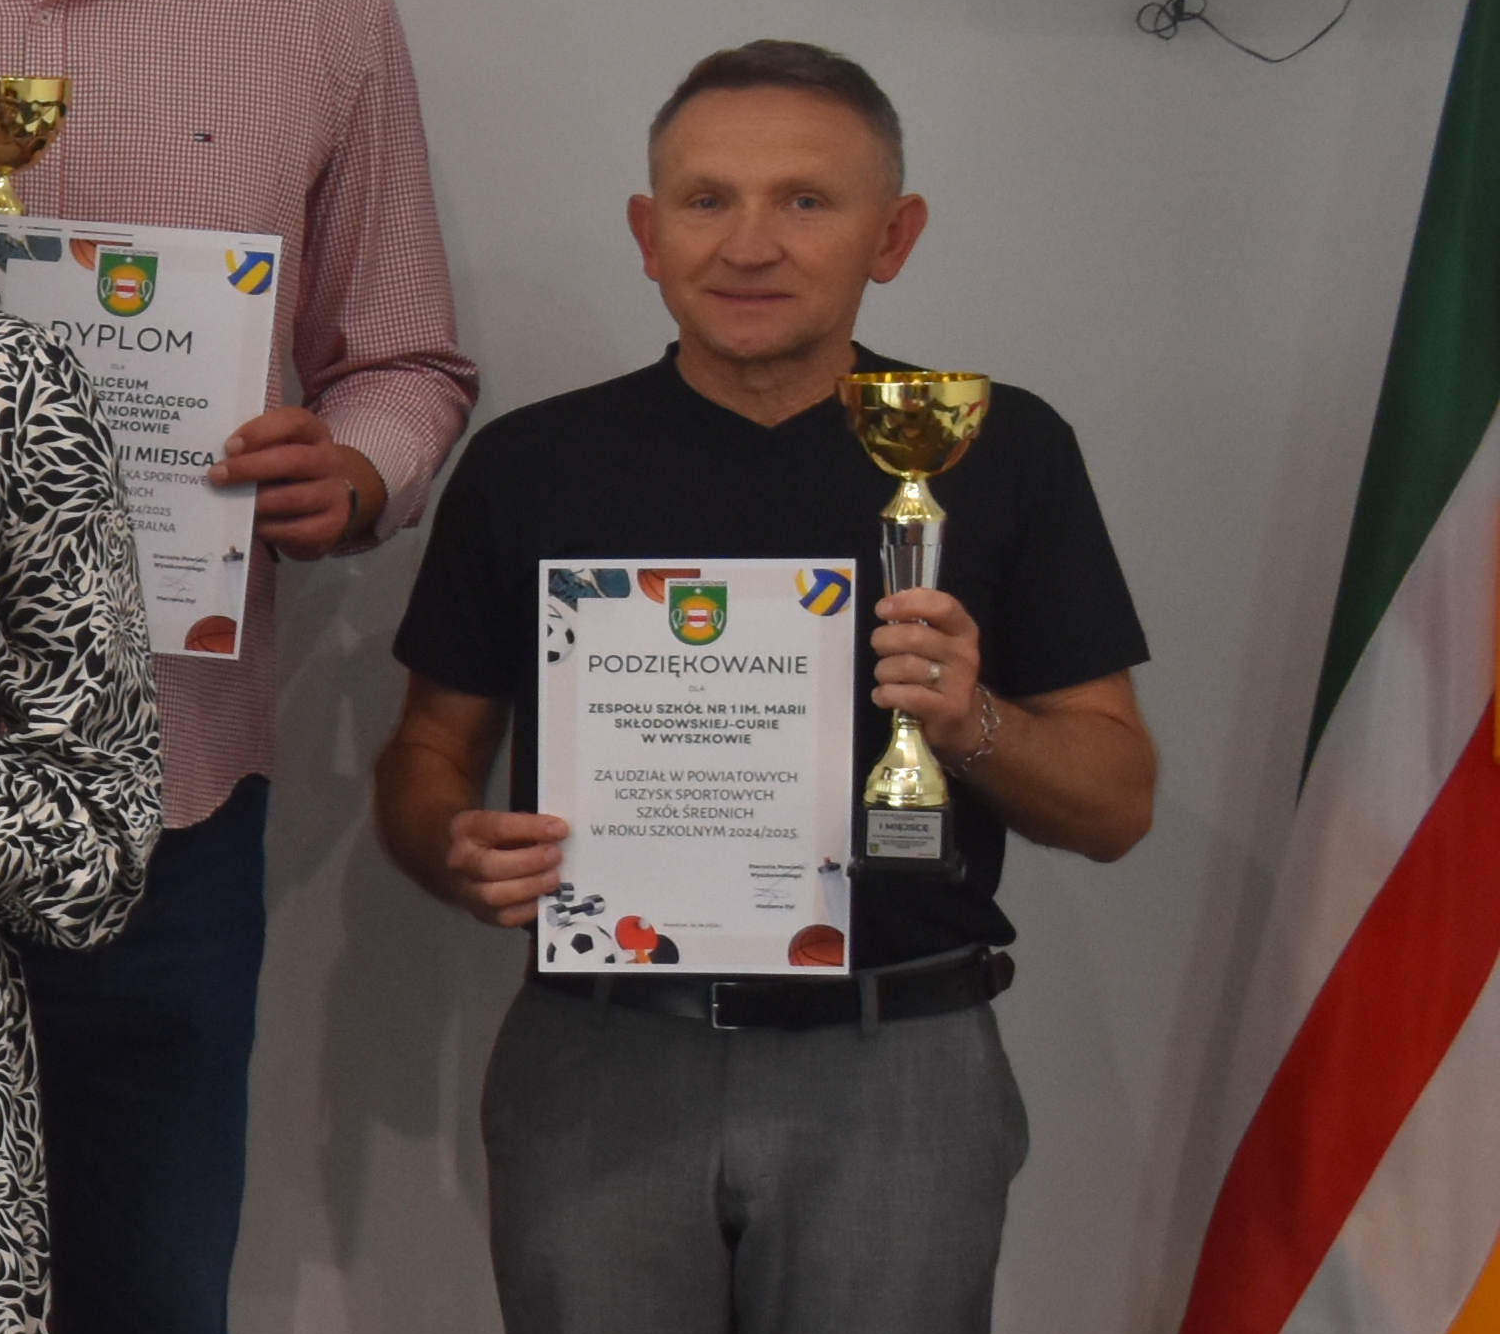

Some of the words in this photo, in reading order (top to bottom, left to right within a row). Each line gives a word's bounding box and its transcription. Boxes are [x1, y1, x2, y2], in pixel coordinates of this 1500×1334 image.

[51, 320, 192, 354] DYPLOM
[92, 375, 148, 390] LICEUM
[98, 390, 208, 409] SZTAŁCĄCEGO
[107, 405, 181, 421] NORWIDA
[108, 420, 170, 434] ZKOWIE
[135, 447, 215, 467] MIEJSCA
[130, 505, 172, 516] 24/2025
[131, 520, 176, 532] ERALNA
[588, 654, 808, 677] PODZIĘKOWANIE
[588, 703, 653, 714] ZESPOŁU
[657, 702, 702, 715] SZKÓŁ
[707, 704, 727, 714] NR
[731, 705, 736, 714] 1
[740, 705, 760, 715] IM.
[764, 704, 806, 715] MARII
[614, 718, 779, 730] SKŁODOWSKIEJ-CURIE
[642, 734, 656, 744] W
[660, 734, 751, 744] WYSZKOWIE
[594, 770, 613, 782] ZA
[615, 770, 667, 782] UDZIAŁ
[670, 771, 684, 782] W
[687, 770, 798, 783] POWIATOWYCH
[615, 789, 673, 800] IGRZYSK
[675, 789, 774, 801] SPORTOWYCH
[636, 804, 679, 819] SZKÓŁ
[682, 804, 754, 819] ŚREDNICH
[590, 824, 606, 836] W
[608, 825, 647, 836] ROKU
[649, 825, 726, 837] SZKOLNYM
